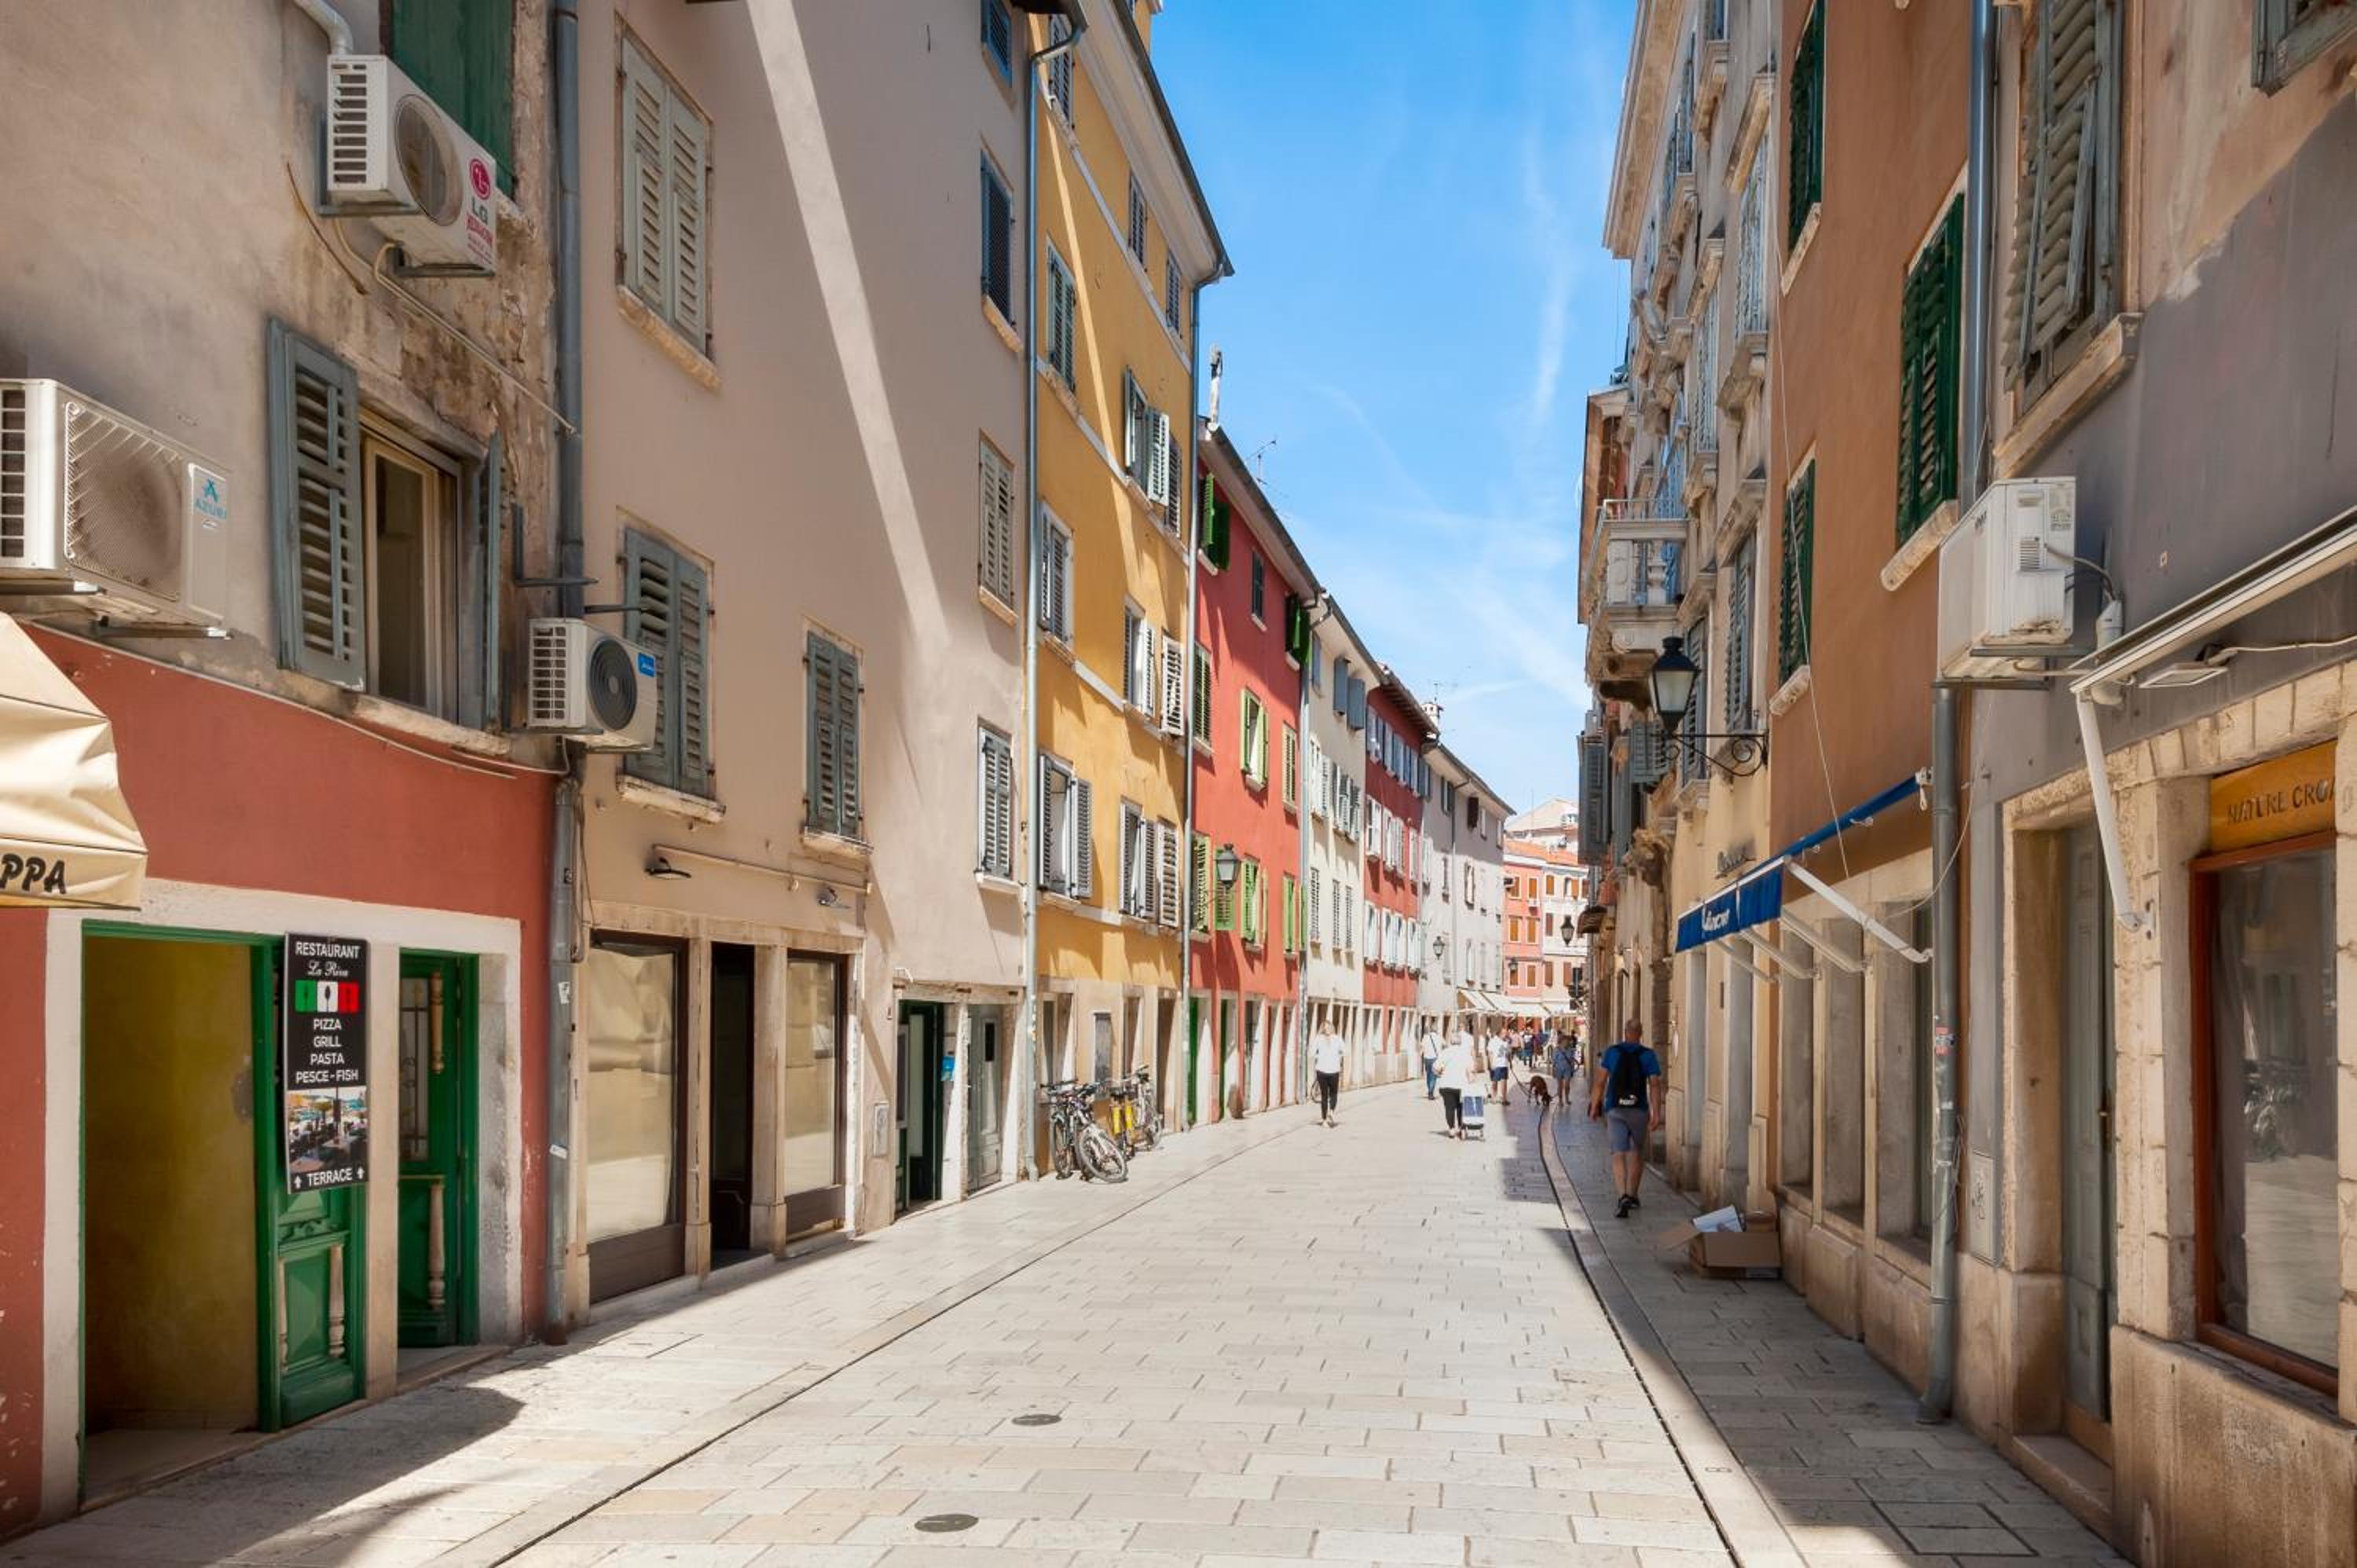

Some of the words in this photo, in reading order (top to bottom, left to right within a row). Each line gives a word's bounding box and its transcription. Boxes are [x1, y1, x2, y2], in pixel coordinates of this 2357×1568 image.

[472, 196, 488, 225] LG
[295, 941, 360, 958] RESTAURANT
[313, 1018, 342, 1030] PIZZA
[313, 1035, 342, 1047] GRILL
[310, 1053, 345, 1064] PASTA
[295, 1071, 328, 1083] PESCE
[335, 1069, 359, 1081] FISH
[306, 1167, 353, 1186] TERRACE
